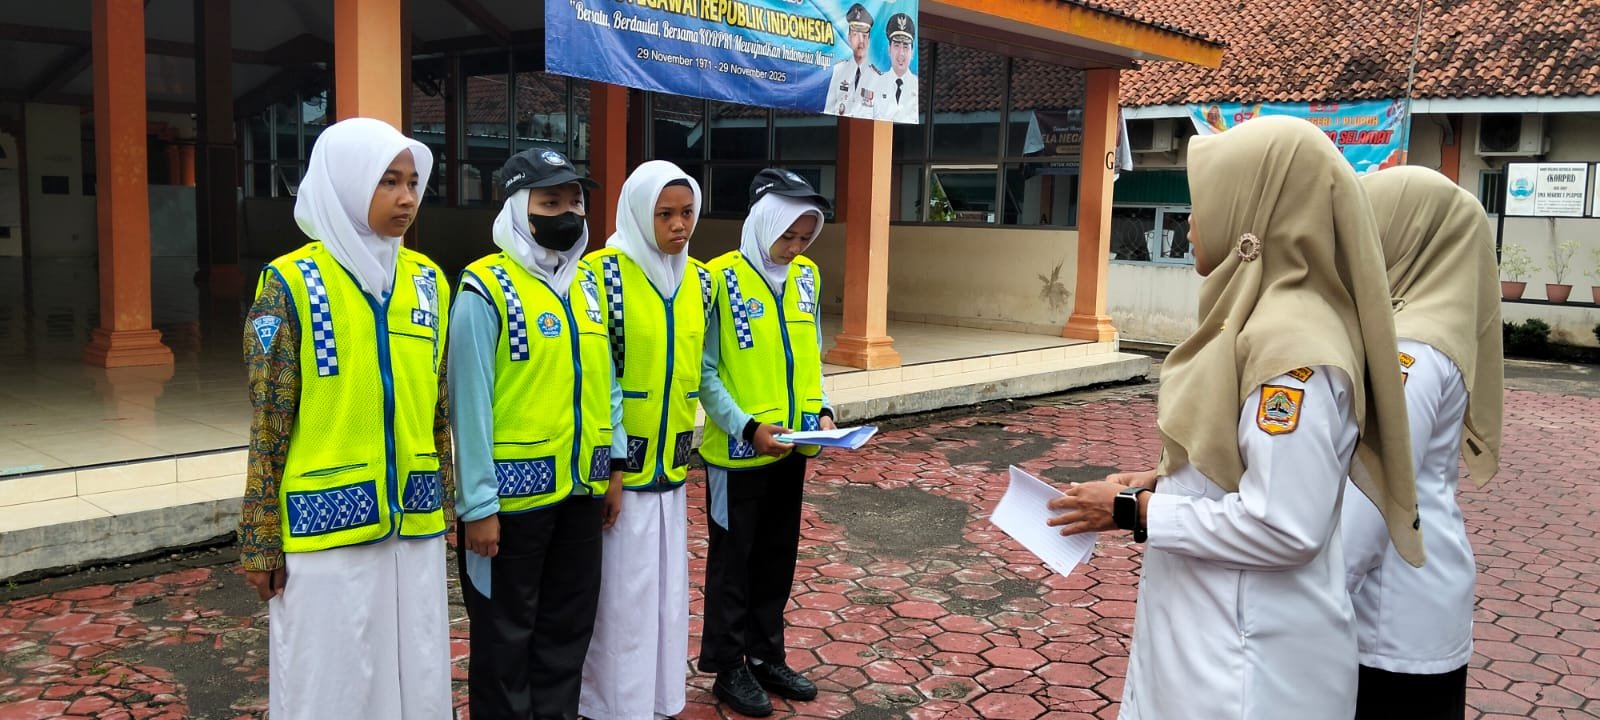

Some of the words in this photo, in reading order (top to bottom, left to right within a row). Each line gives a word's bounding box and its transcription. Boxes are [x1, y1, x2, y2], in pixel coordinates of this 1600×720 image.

[663, 20, 698, 44] Bersama
[699, 28, 732, 50] KORPRI
[782, 45, 814, 64] Indonesia
[766, 8, 834, 45] INDONESIA
[637, 47, 649, 60] 29
[651, 50, 693, 67] November
[695, 58, 712, 70] 1971
[719, 62, 728, 73] 29
[730, 65, 767, 79] November
[768, 70, 786, 82] 2025
[1339, 129, 1393, 145] SELAMAT
[1105, 151, 1114, 170] G
